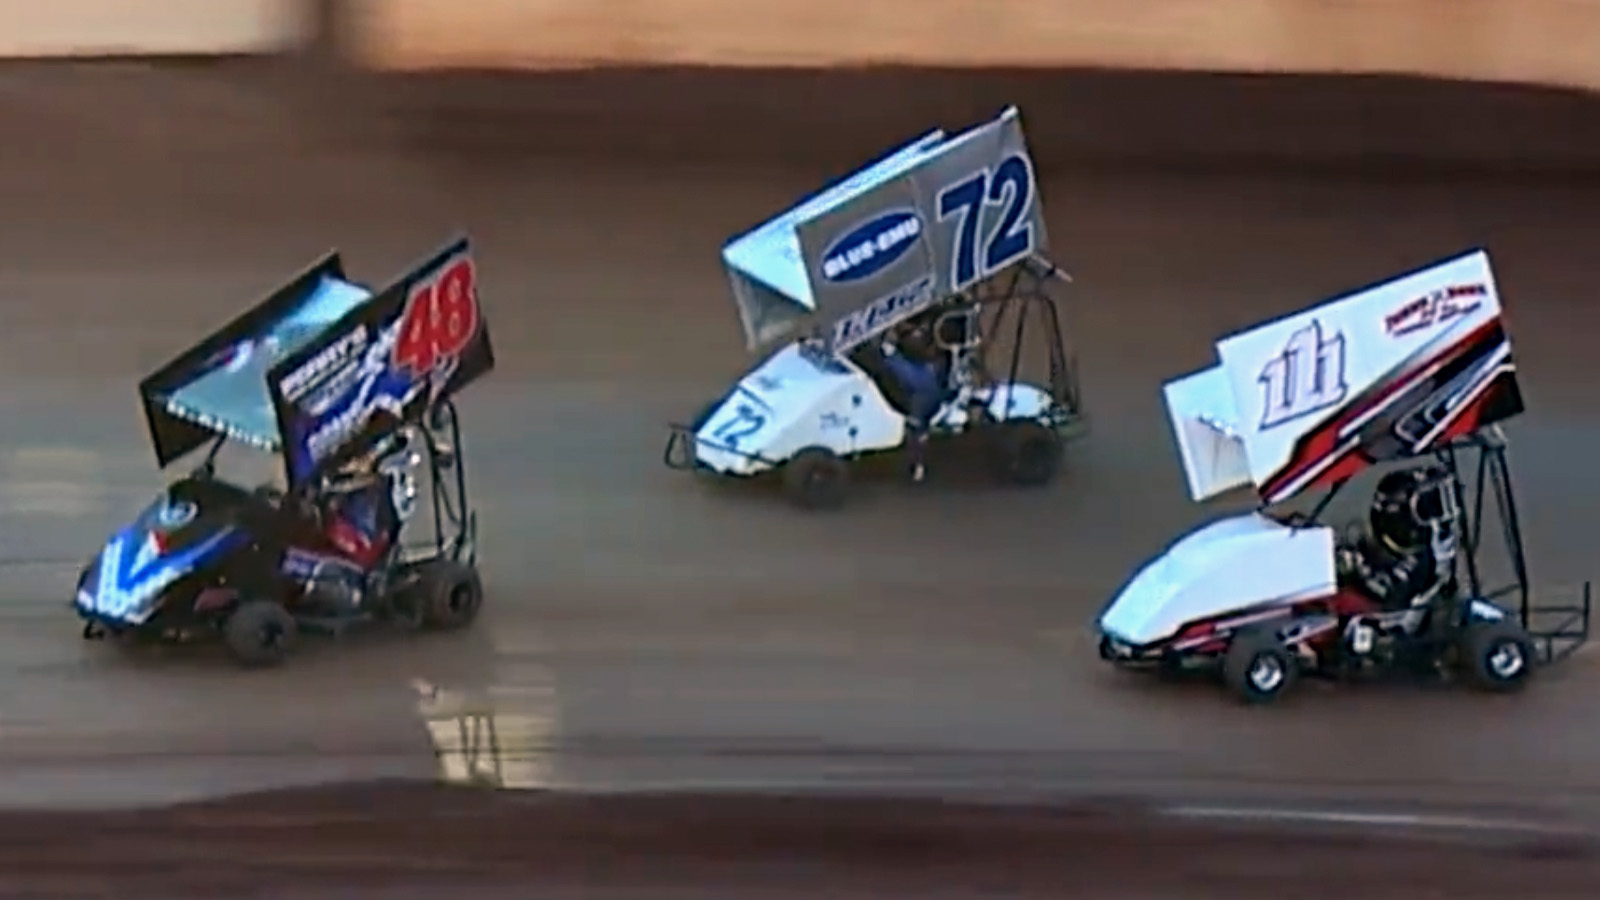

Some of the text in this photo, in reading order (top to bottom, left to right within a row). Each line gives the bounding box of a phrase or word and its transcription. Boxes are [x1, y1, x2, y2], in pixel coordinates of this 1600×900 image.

[823, 216, 920, 278] BLUE-EMU
[936, 151, 1034, 292] 72
[392, 256, 477, 374] 48
[711, 403, 766, 450] 72
